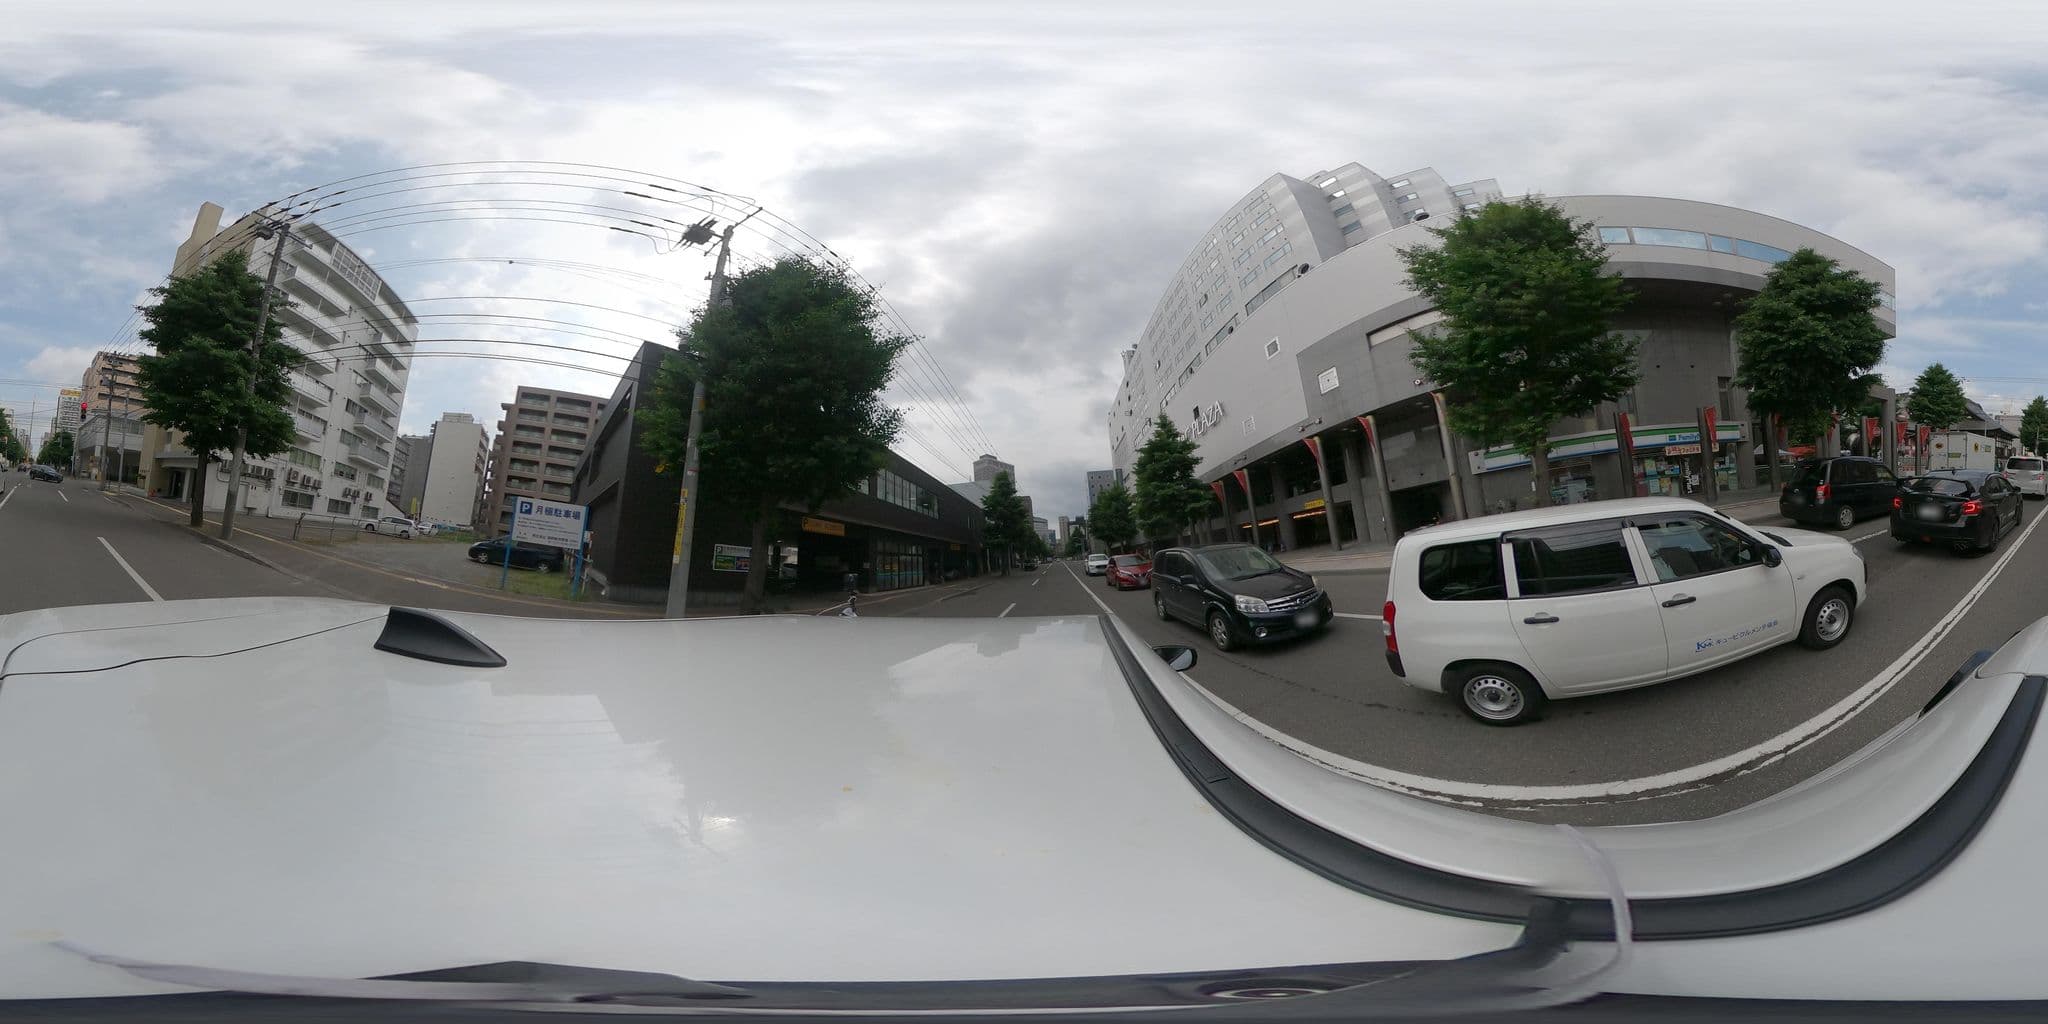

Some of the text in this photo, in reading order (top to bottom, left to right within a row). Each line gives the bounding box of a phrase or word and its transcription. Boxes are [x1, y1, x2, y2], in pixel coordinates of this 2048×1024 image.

[1192, 400, 1223, 439] PLAZA
[536, 505, 581, 520] 月極駐車場
